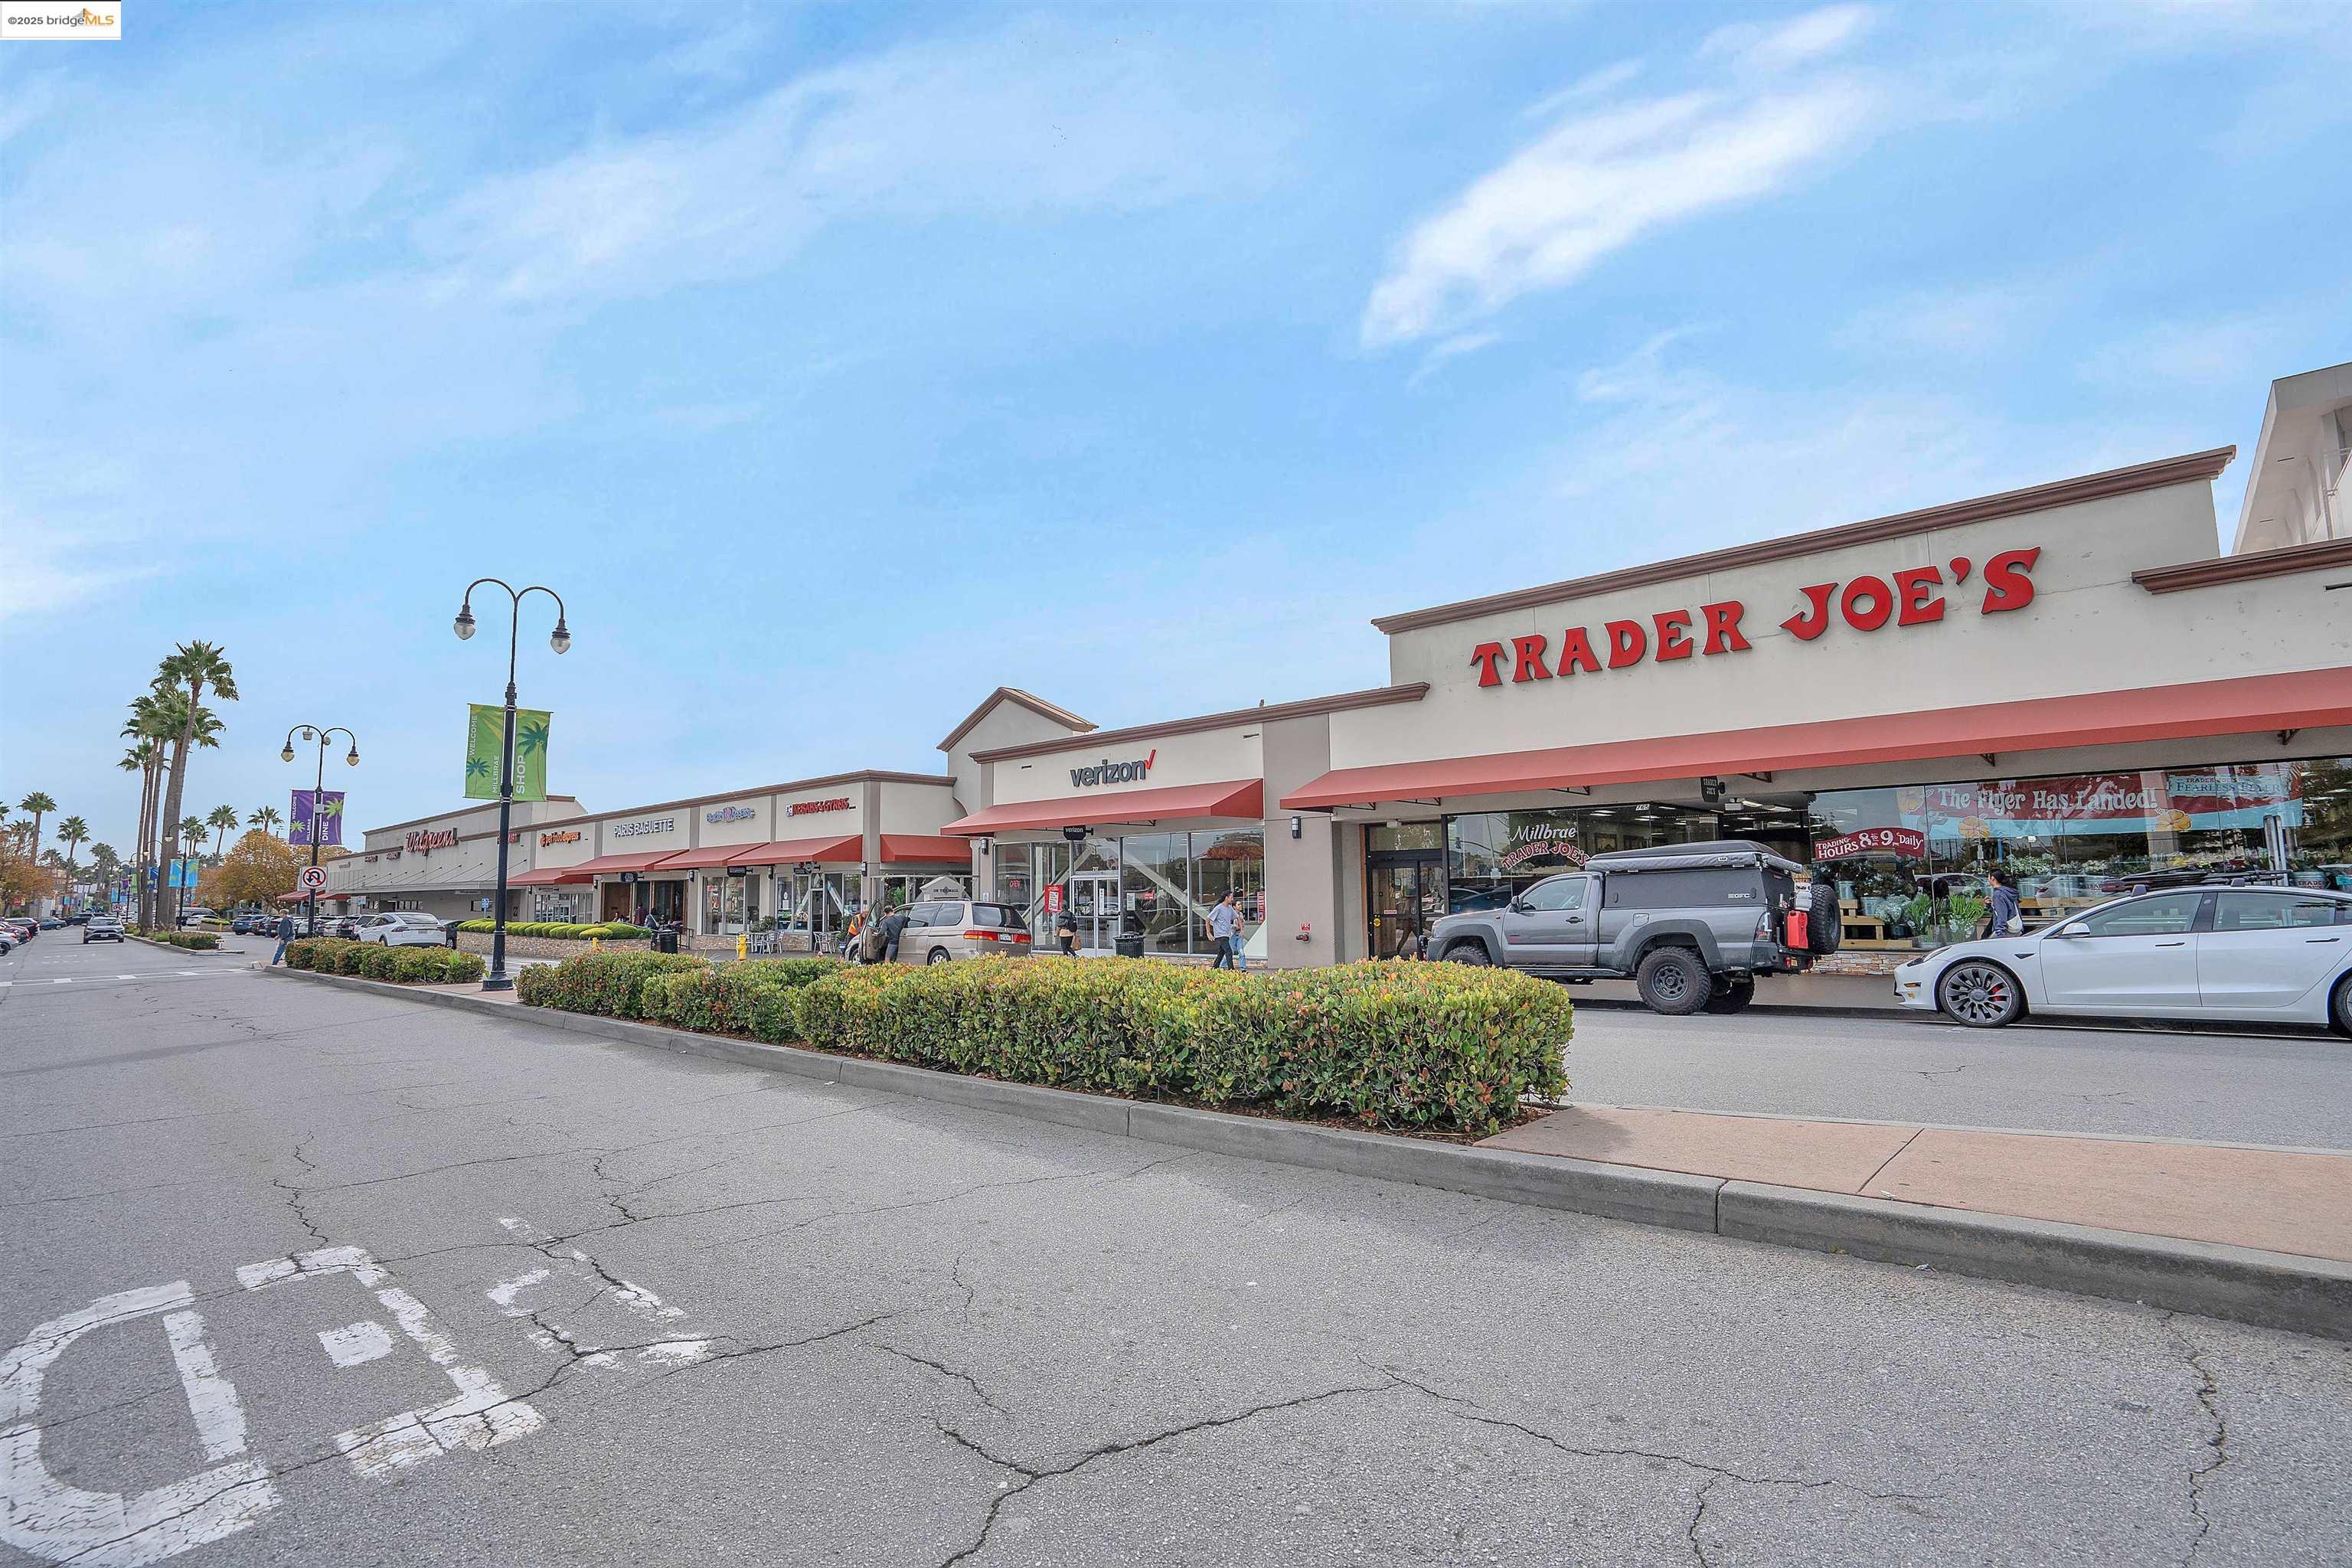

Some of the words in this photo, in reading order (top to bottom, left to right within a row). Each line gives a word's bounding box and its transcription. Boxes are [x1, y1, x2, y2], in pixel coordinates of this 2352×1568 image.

[1470, 600, 1753, 688] TRADER
[1779, 546, 2041, 641] JOE'S
[469, 715, 478, 755] WELCOME
[516, 755, 525, 794] SHOP
[1070, 760, 1146, 787] verizon
[2176, 782, 2236, 792] FEARLESS
[1938, 788, 1970, 809] The
[1977, 789, 2026, 815] Flyer
[2033, 790, 2069, 810] Has
[2076, 788, 2158, 810] Landed!
[612, 824, 635, 838] PARIS
[635, 818, 674, 835] BAGUETTE
[1510, 823, 1578, 841] Millbrae
[1501, 841, 1550, 870] TRADER
[1550, 841, 1590, 866] JOE'S
[1816, 838, 1851, 850] TRADING
[1818, 841, 1859, 858] HOURS
[1859, 832, 1871, 848] 8
[1880, 830, 1893, 845] 9
[1896, 832, 1923, 849] Daily
